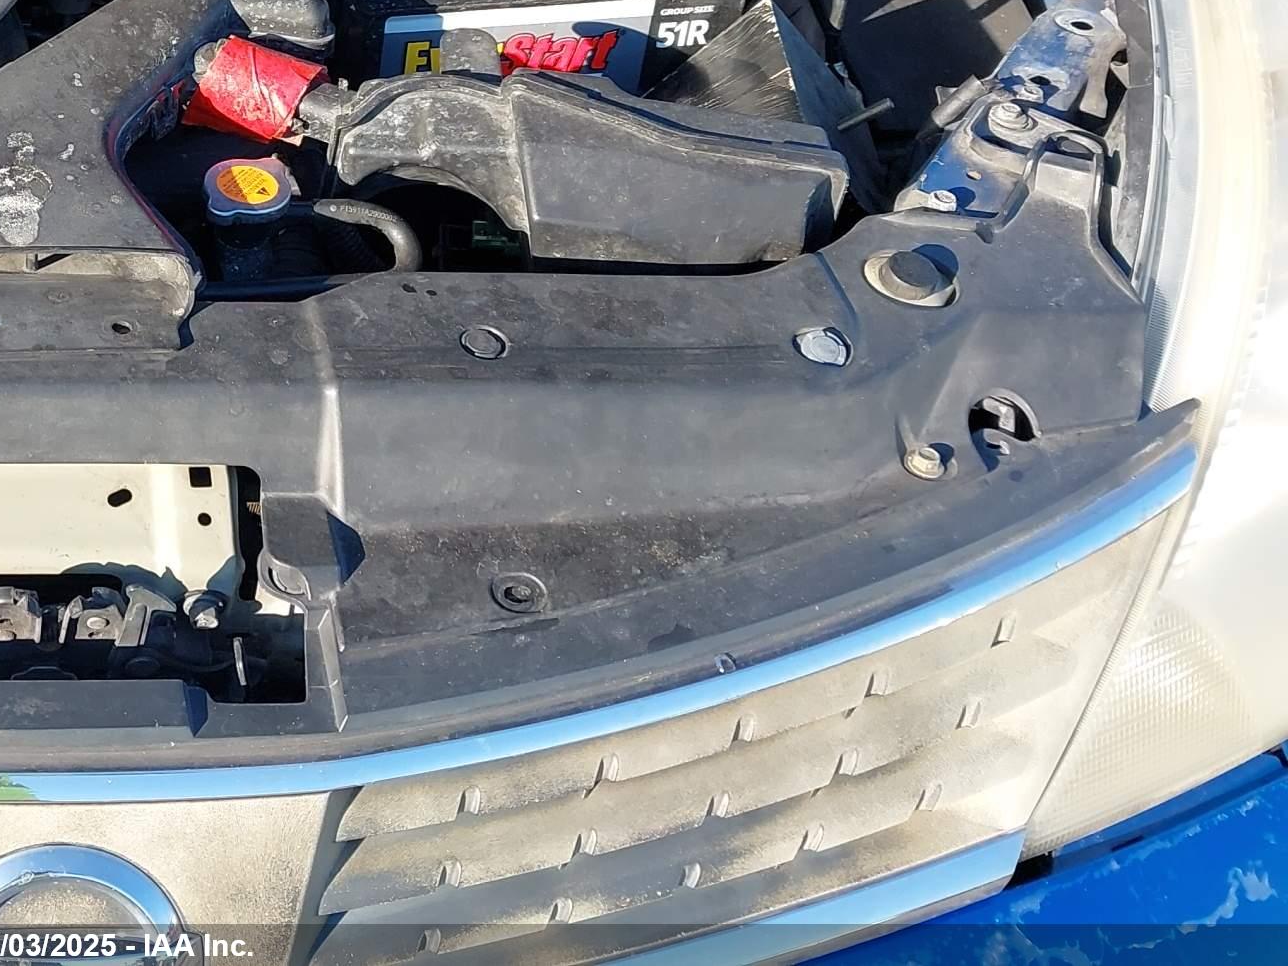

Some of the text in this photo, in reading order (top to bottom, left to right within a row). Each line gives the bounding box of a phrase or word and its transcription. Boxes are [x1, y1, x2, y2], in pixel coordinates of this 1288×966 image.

[660, 5, 716, 16] GROUP SIZE
[655, 18, 710, 49] 51R
